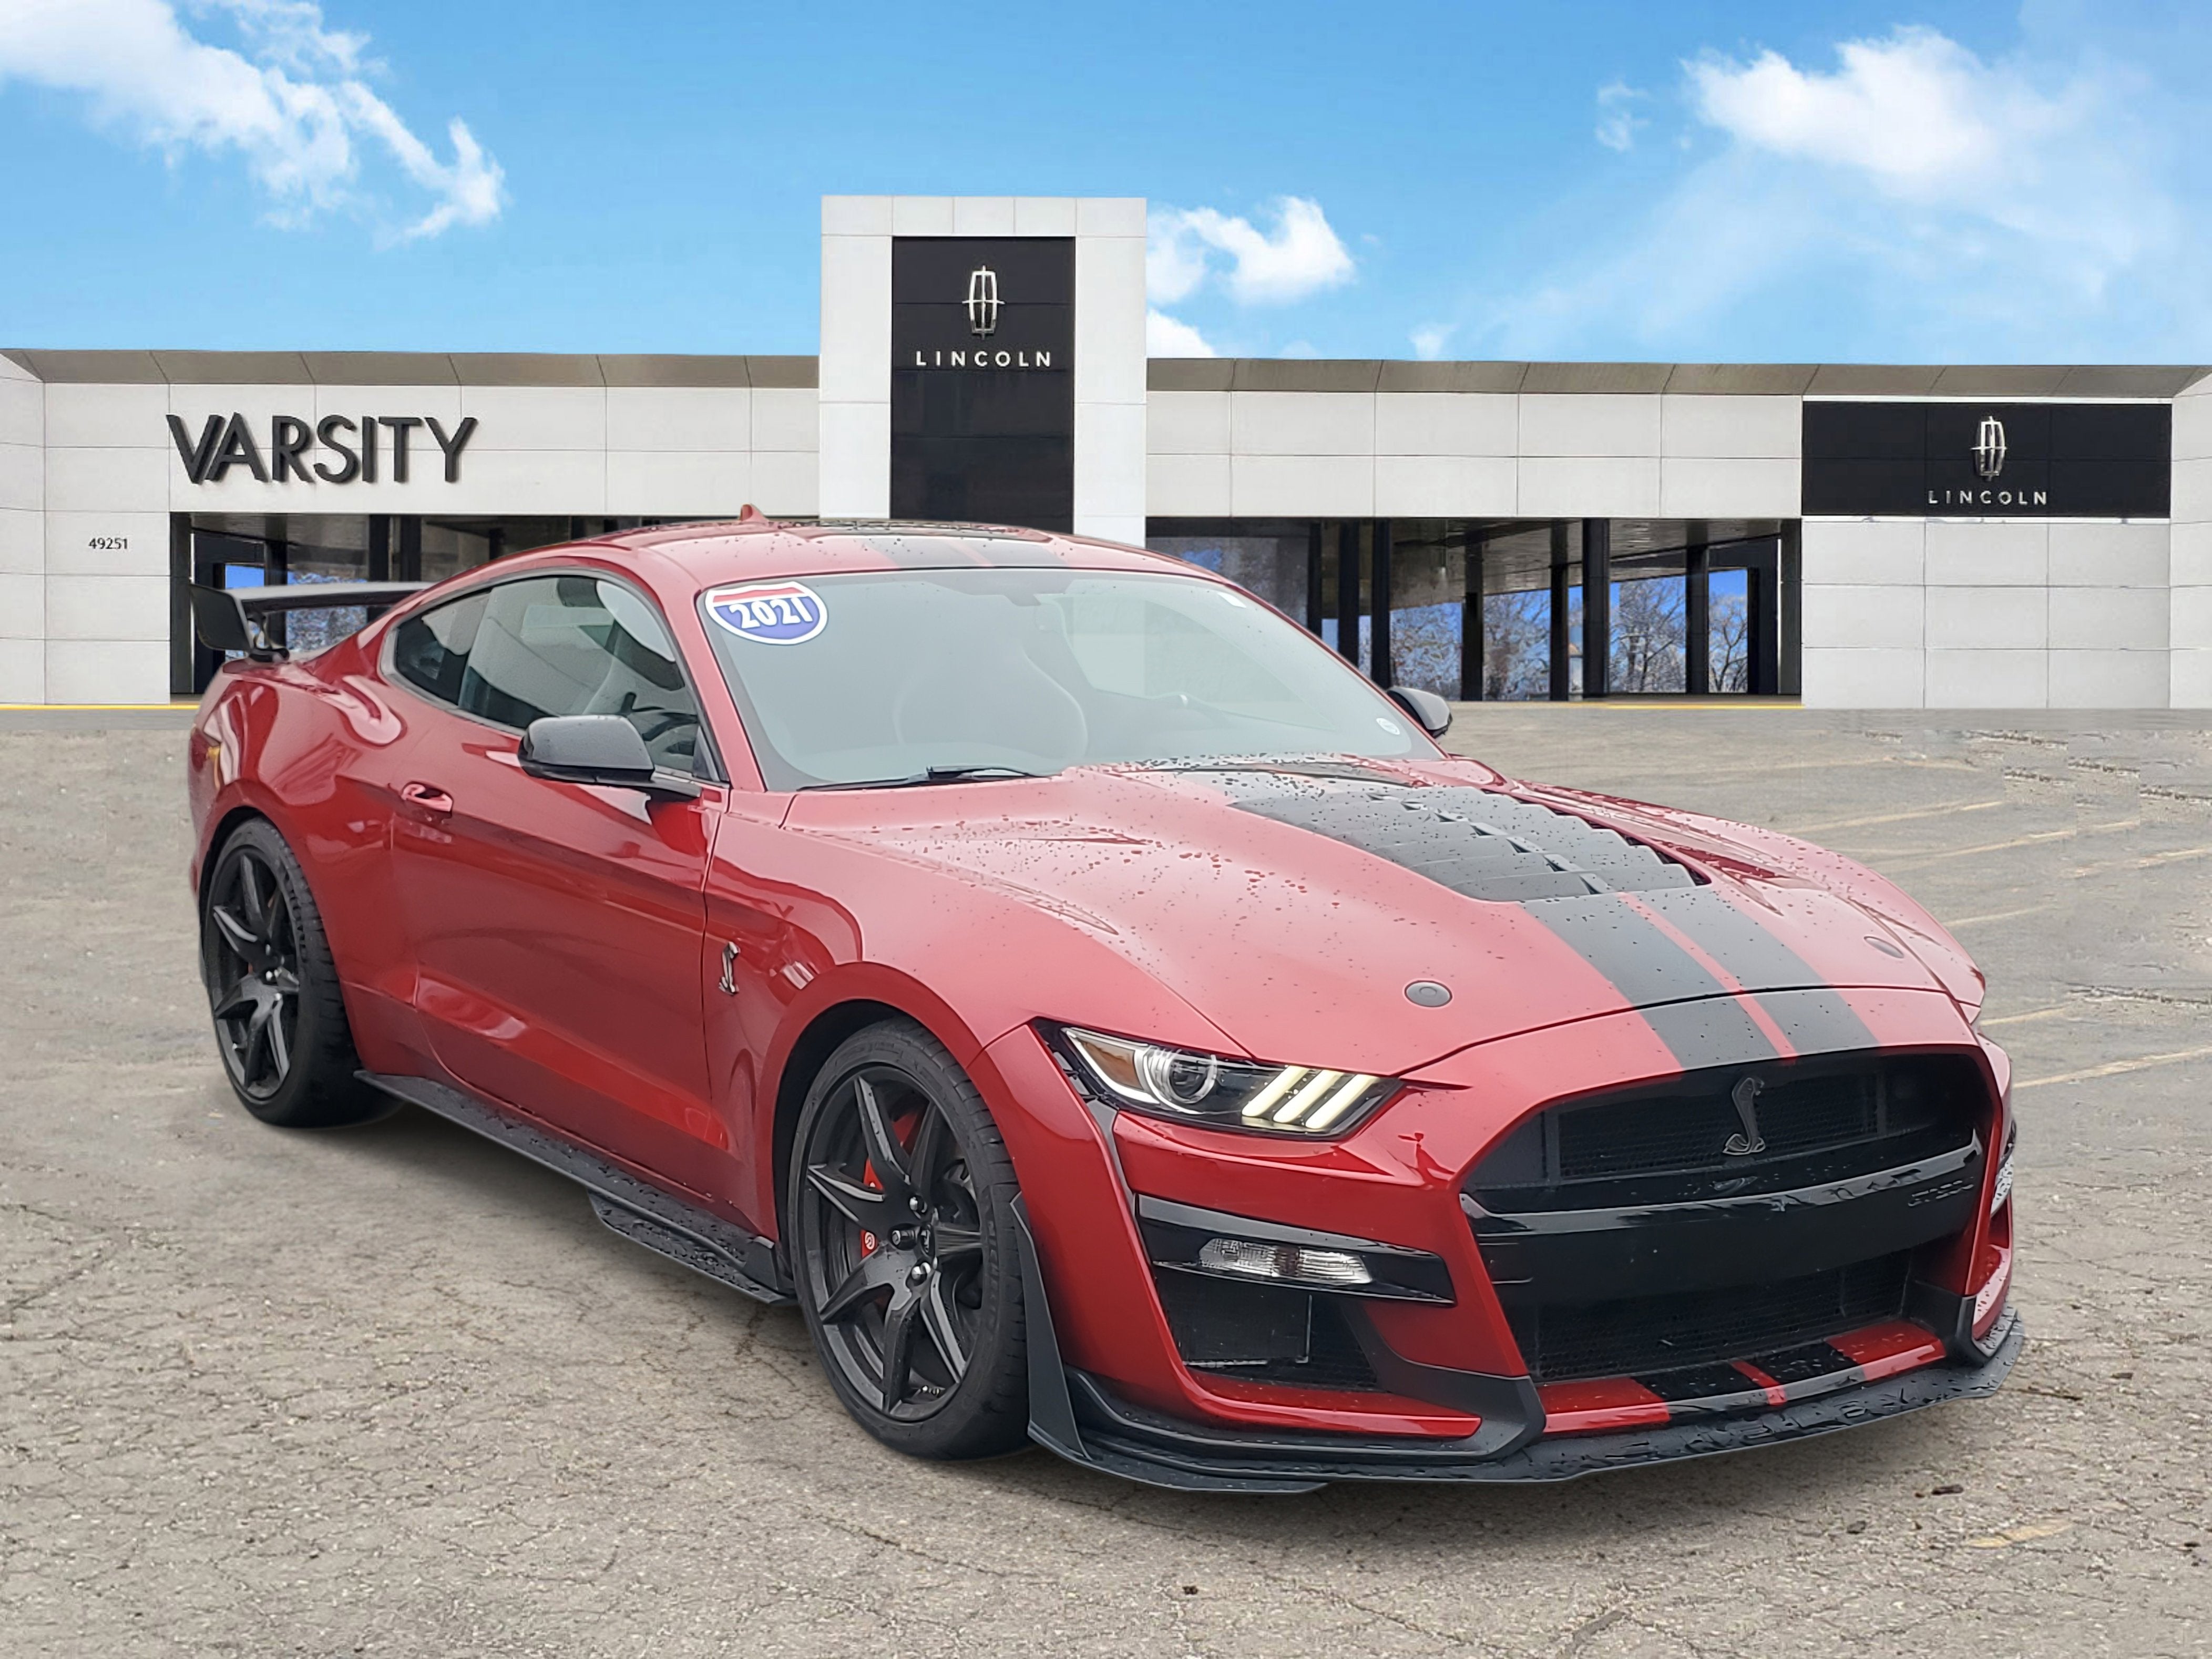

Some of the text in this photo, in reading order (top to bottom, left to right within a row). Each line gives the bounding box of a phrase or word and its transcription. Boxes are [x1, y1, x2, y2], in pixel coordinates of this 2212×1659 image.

[916, 351, 1051, 367] LINCOLN
[166, 413, 478, 484] VARSITY
[1928, 490, 2047, 505] LINCOLN
[88, 537, 128, 549] 49251
[729, 597, 813, 629] 2021
